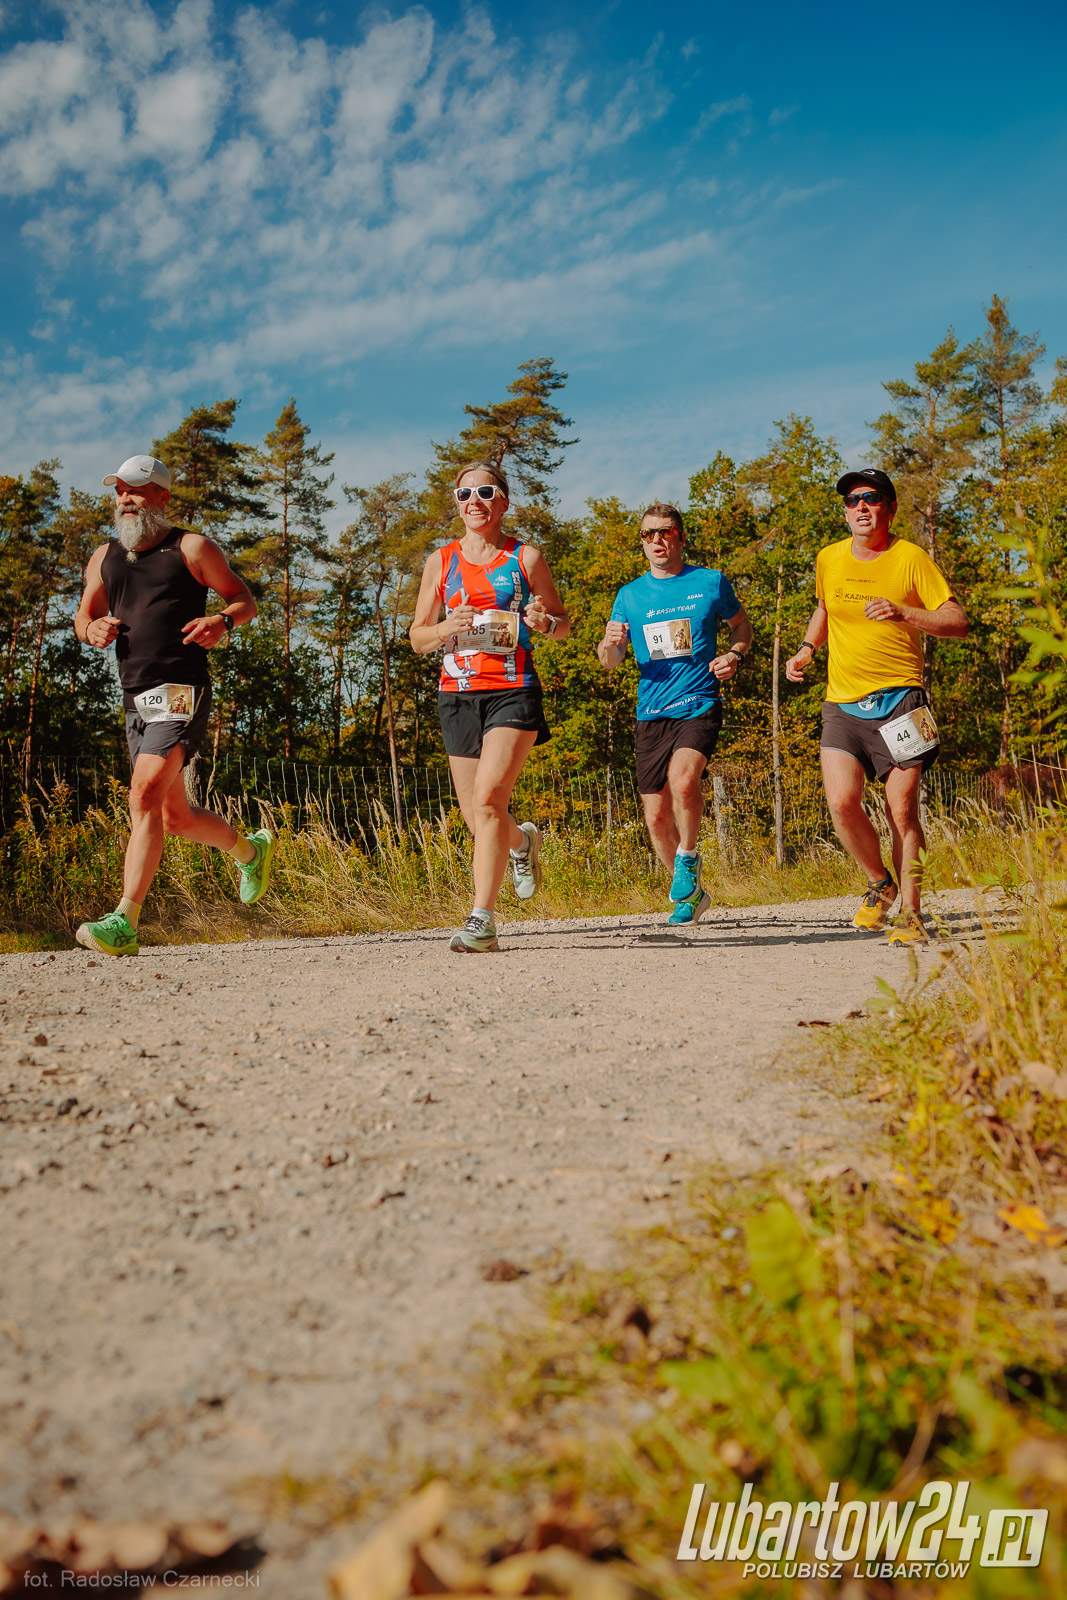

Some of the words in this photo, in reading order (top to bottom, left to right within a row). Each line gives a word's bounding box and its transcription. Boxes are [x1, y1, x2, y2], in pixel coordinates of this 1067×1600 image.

[677, 603, 697, 612] TEAM
[652, 634, 663, 644] 91
[142, 695, 163, 706] 120
[896, 729, 911, 742] 44
